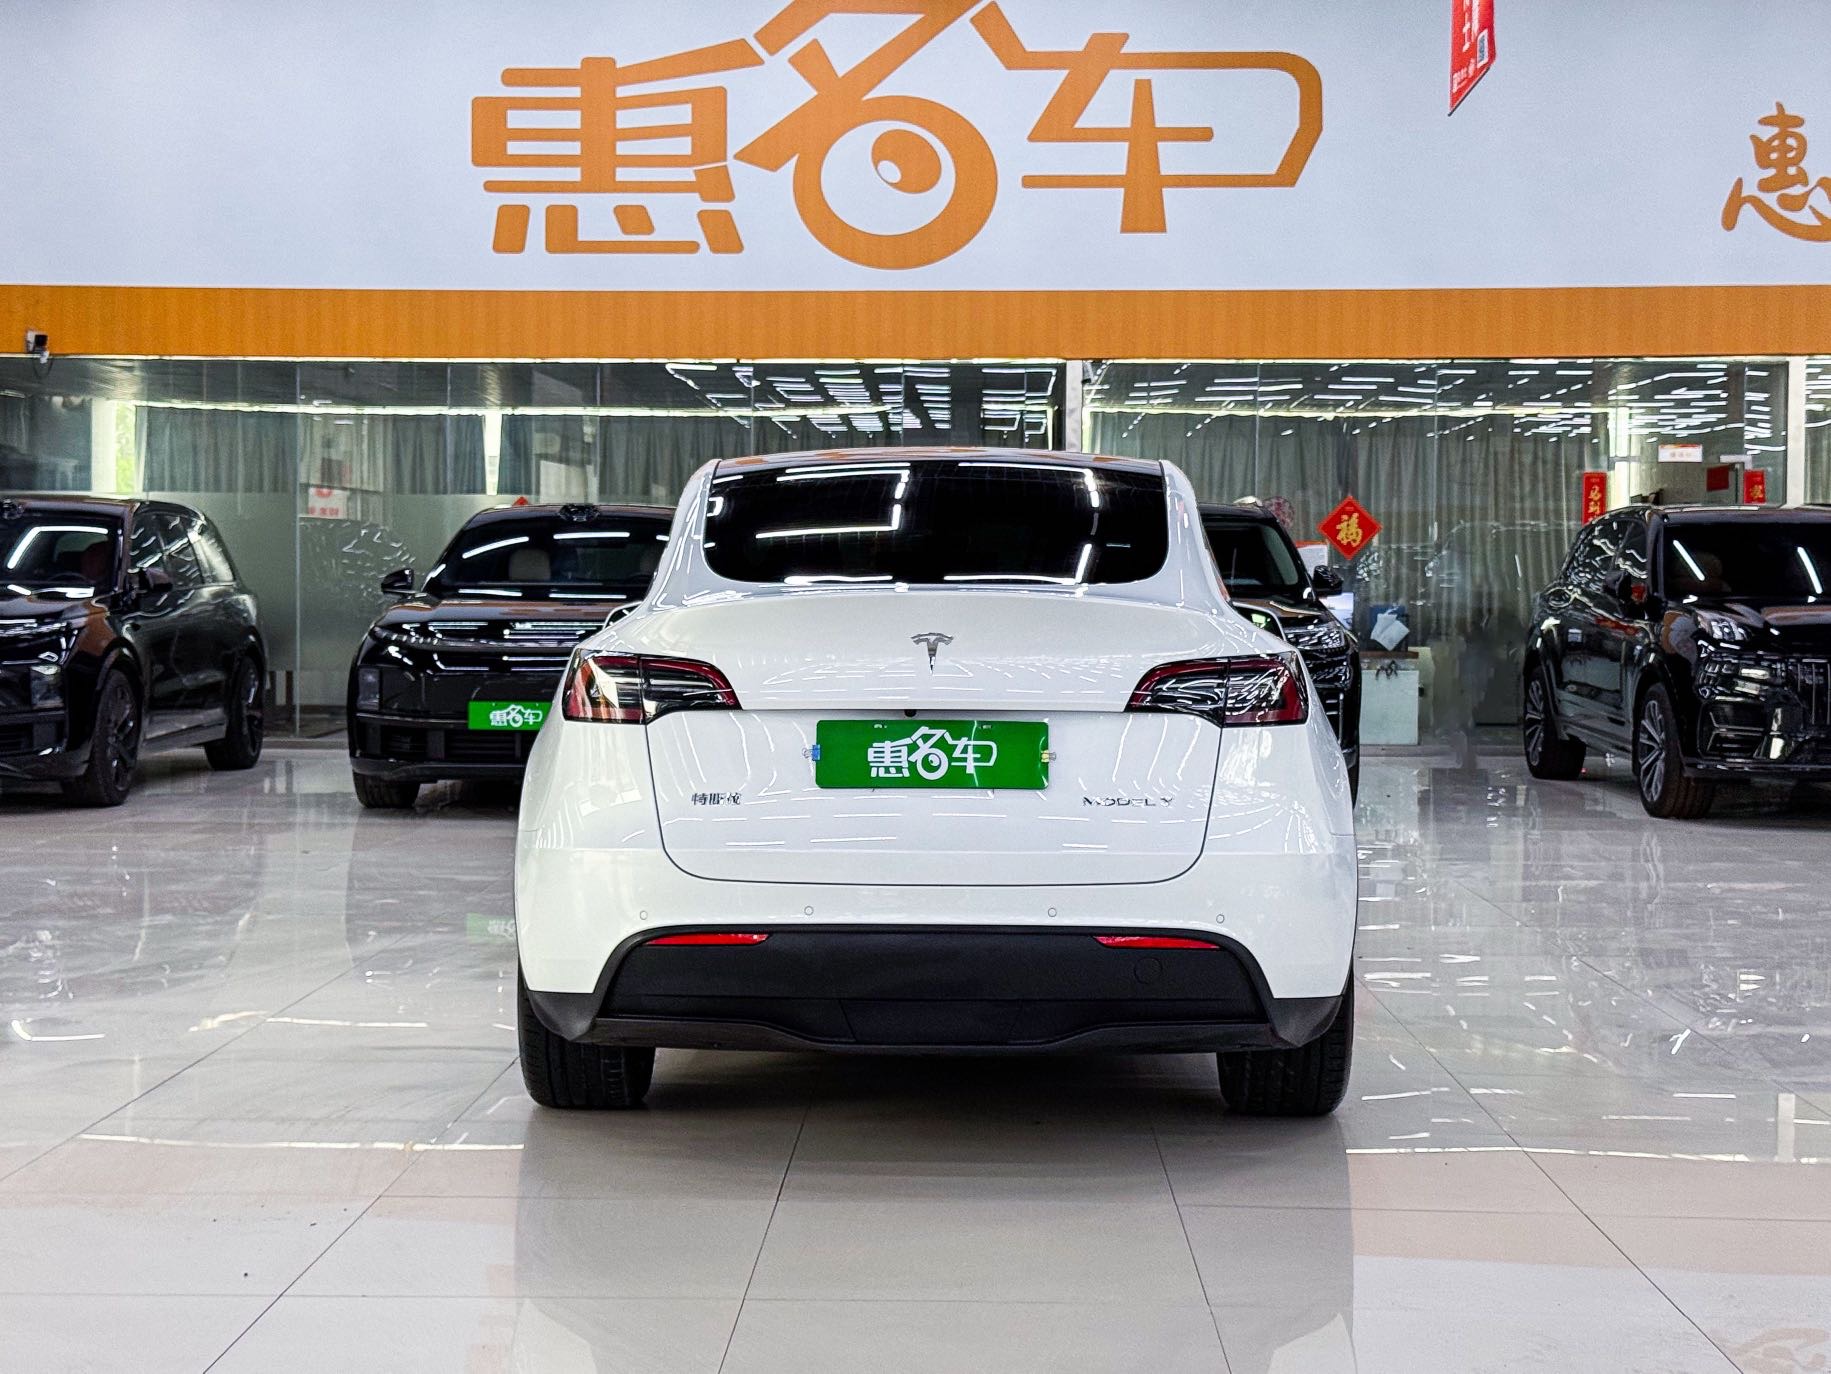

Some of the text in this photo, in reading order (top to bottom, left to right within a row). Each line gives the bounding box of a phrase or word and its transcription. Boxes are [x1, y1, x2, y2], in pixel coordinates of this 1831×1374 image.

[471, 0, 1324, 270] 惠名车
[1336, 512, 1363, 548] 福
[489, 704, 543, 728] 惠名车
[867, 725, 998, 780] 惠名车
